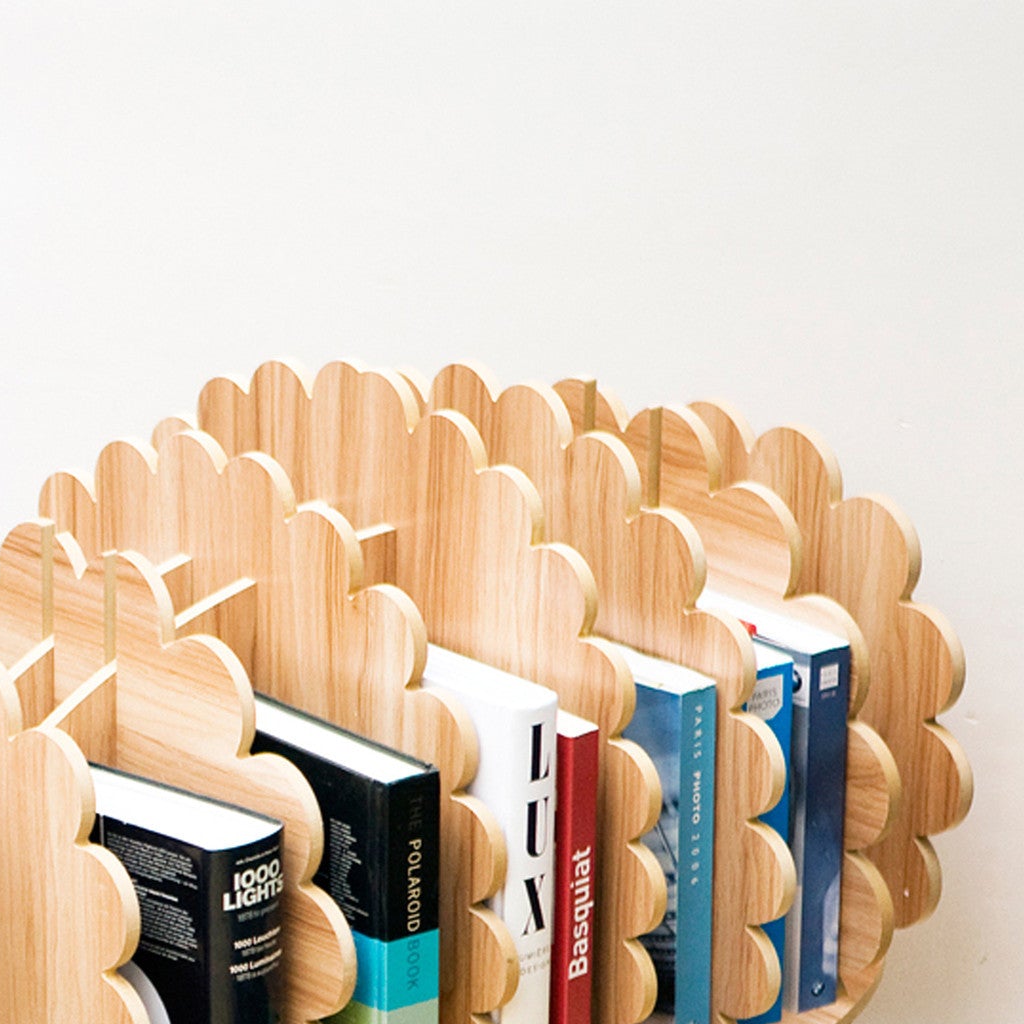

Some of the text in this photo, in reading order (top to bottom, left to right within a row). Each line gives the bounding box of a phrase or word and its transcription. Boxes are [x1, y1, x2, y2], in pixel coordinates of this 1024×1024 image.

[693, 705, 703, 759] PARIS
[692, 770, 702, 825] PHOTO
[521, 723, 551, 936] LUX
[223, 873, 284, 912] LIGHTS
[233, 858, 281, 891] 1000
[407, 838, 423, 932] POLAROID
[568, 845, 595, 980] Basquiat
[406, 939, 421, 990] BOOK
